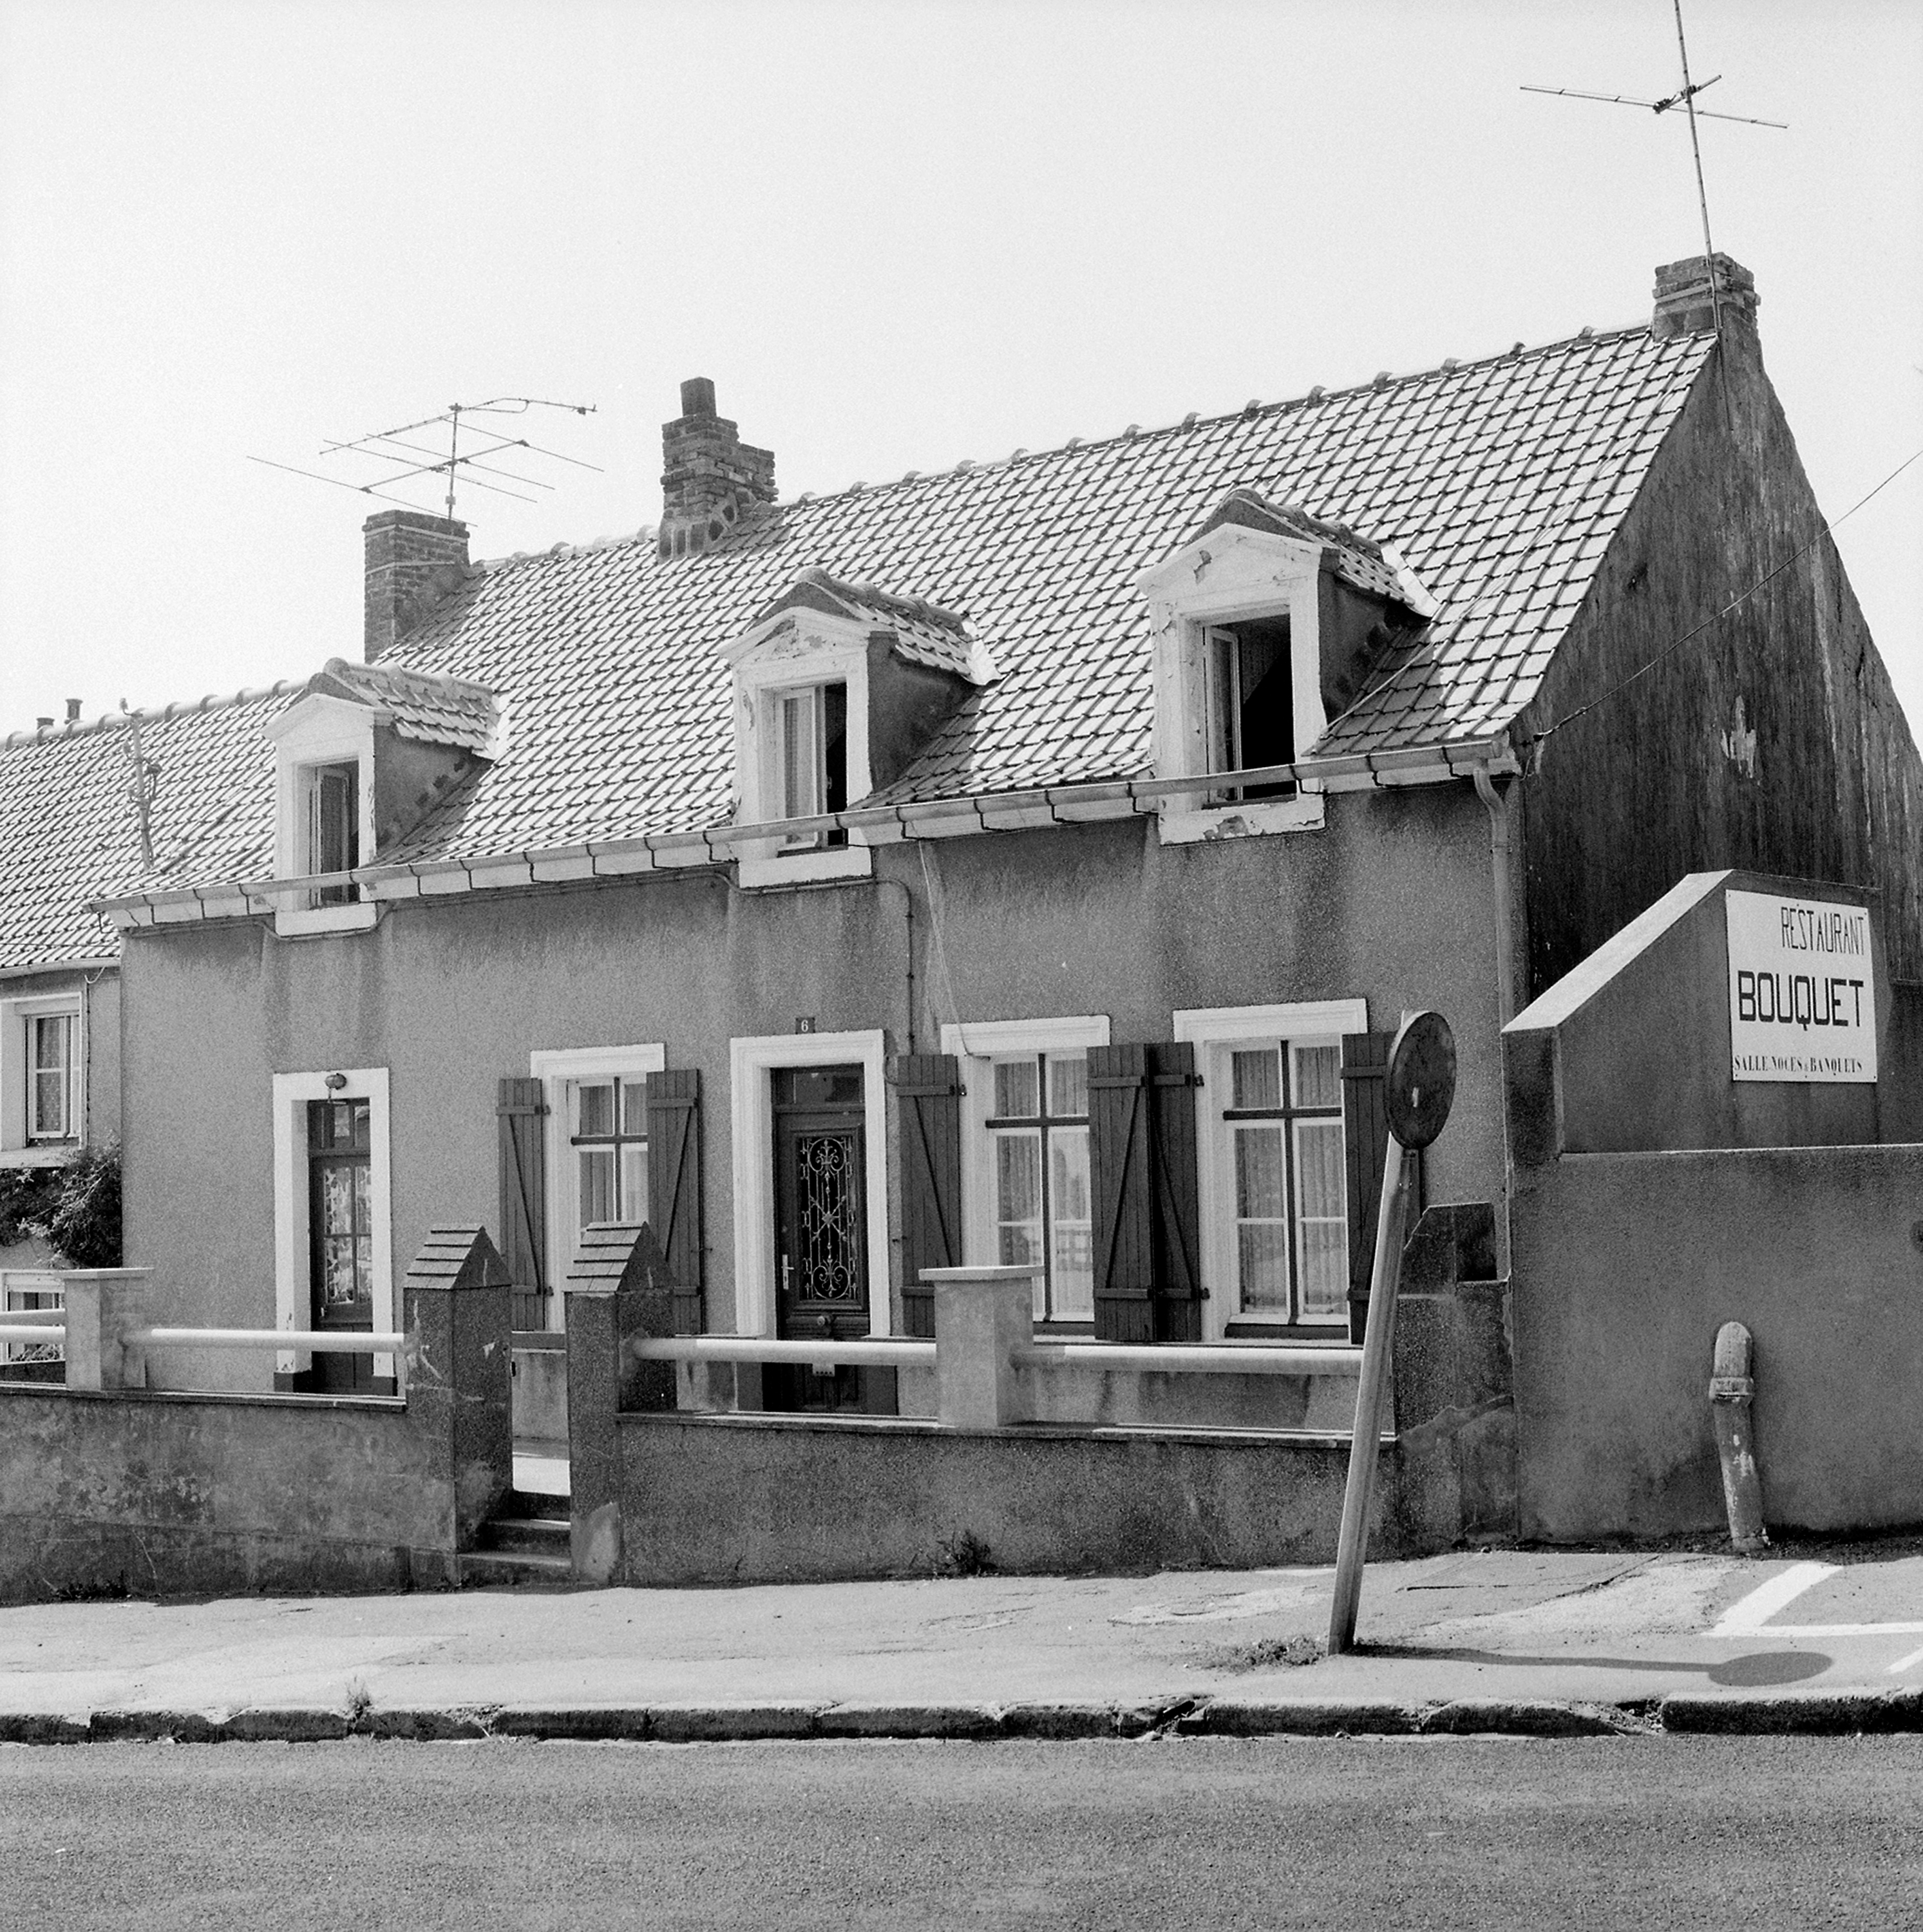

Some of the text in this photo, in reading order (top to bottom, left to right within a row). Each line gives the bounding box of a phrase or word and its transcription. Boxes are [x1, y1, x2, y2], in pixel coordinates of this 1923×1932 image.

[1781, 907, 1864, 955] RESTAURANT
[1738, 971, 1864, 1031] BOUQUET
[801, 1019, 808, 1032] 6
[1734, 1055, 1768, 1071] SALLE
[1810, 1057, 1862, 1073] BANQUETS
